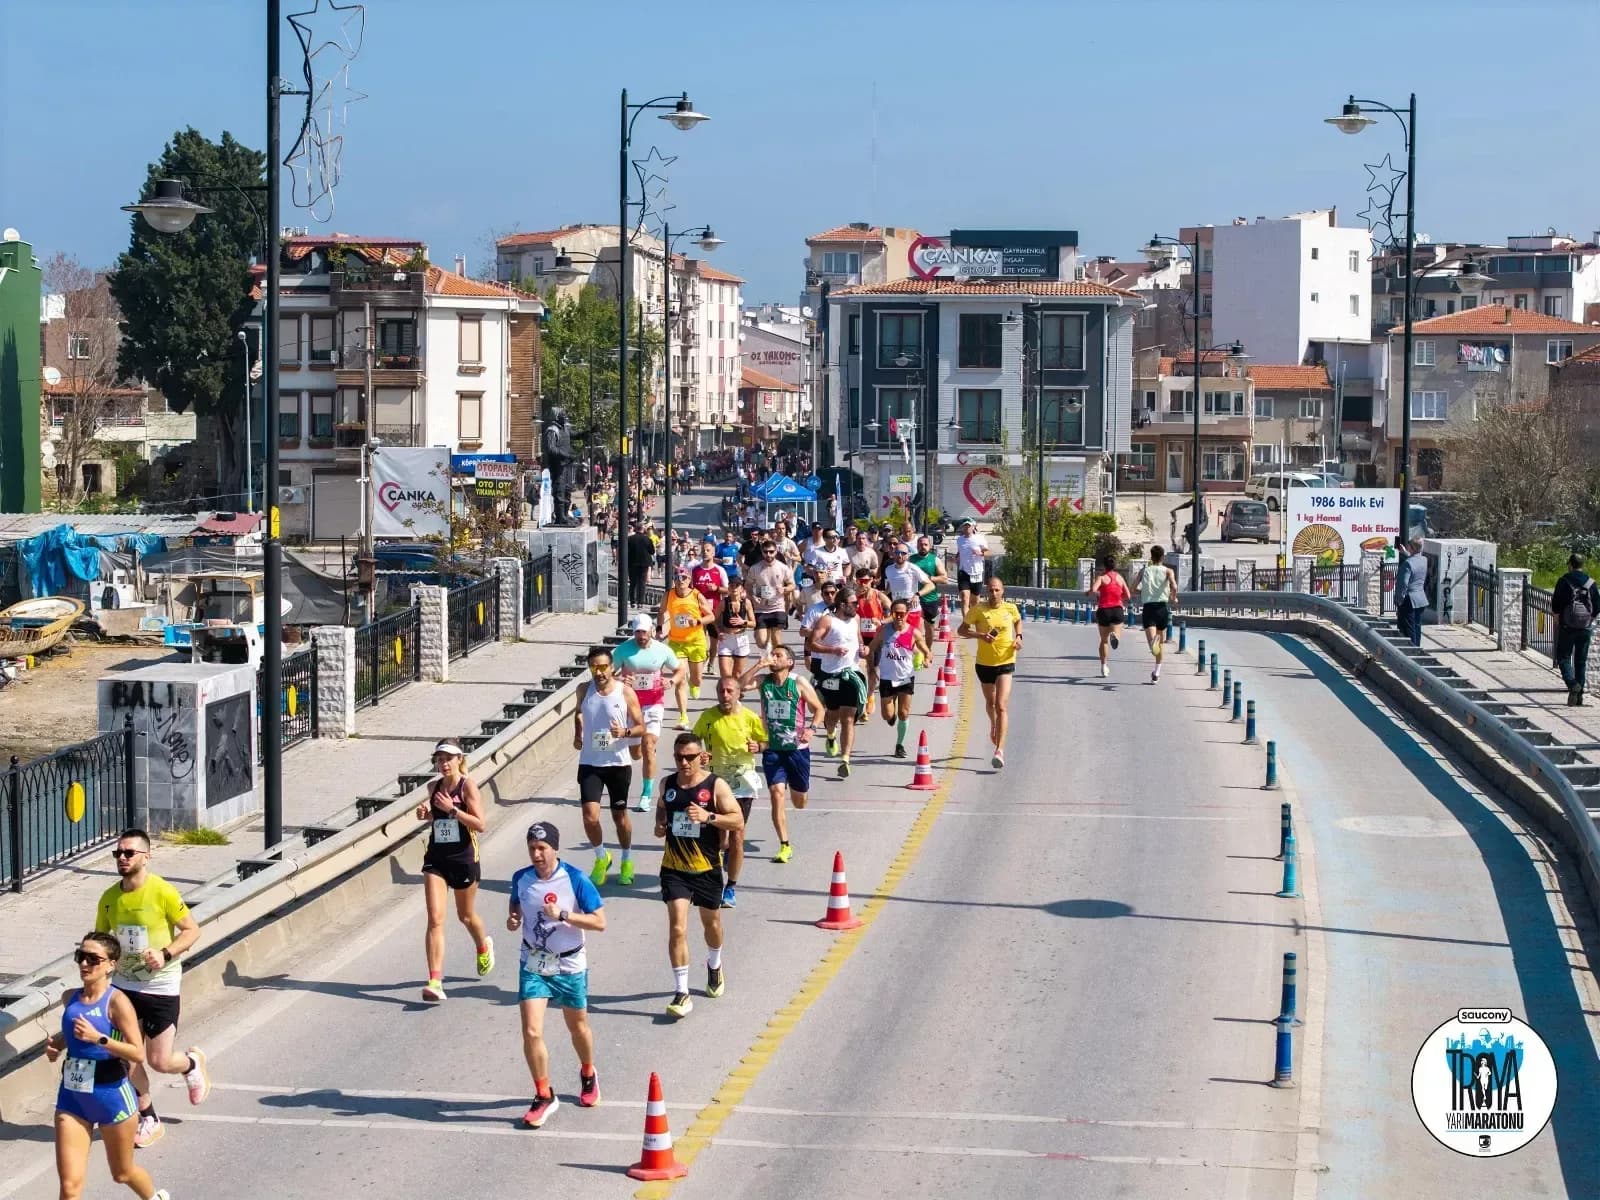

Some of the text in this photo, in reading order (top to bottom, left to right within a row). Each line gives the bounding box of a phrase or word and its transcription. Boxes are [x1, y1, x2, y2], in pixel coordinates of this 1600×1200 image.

[923, 248, 997, 264] ÇANKA
[960, 265, 998, 275] GROUP
[478, 480, 494, 488] OTO
[1310, 496, 1385, 508] 1986 Balık Evi
[1303, 514, 1314, 523] kg
[1351, 524, 1400, 533] Balık Ekme
[70, 1072, 84, 1082] 246
